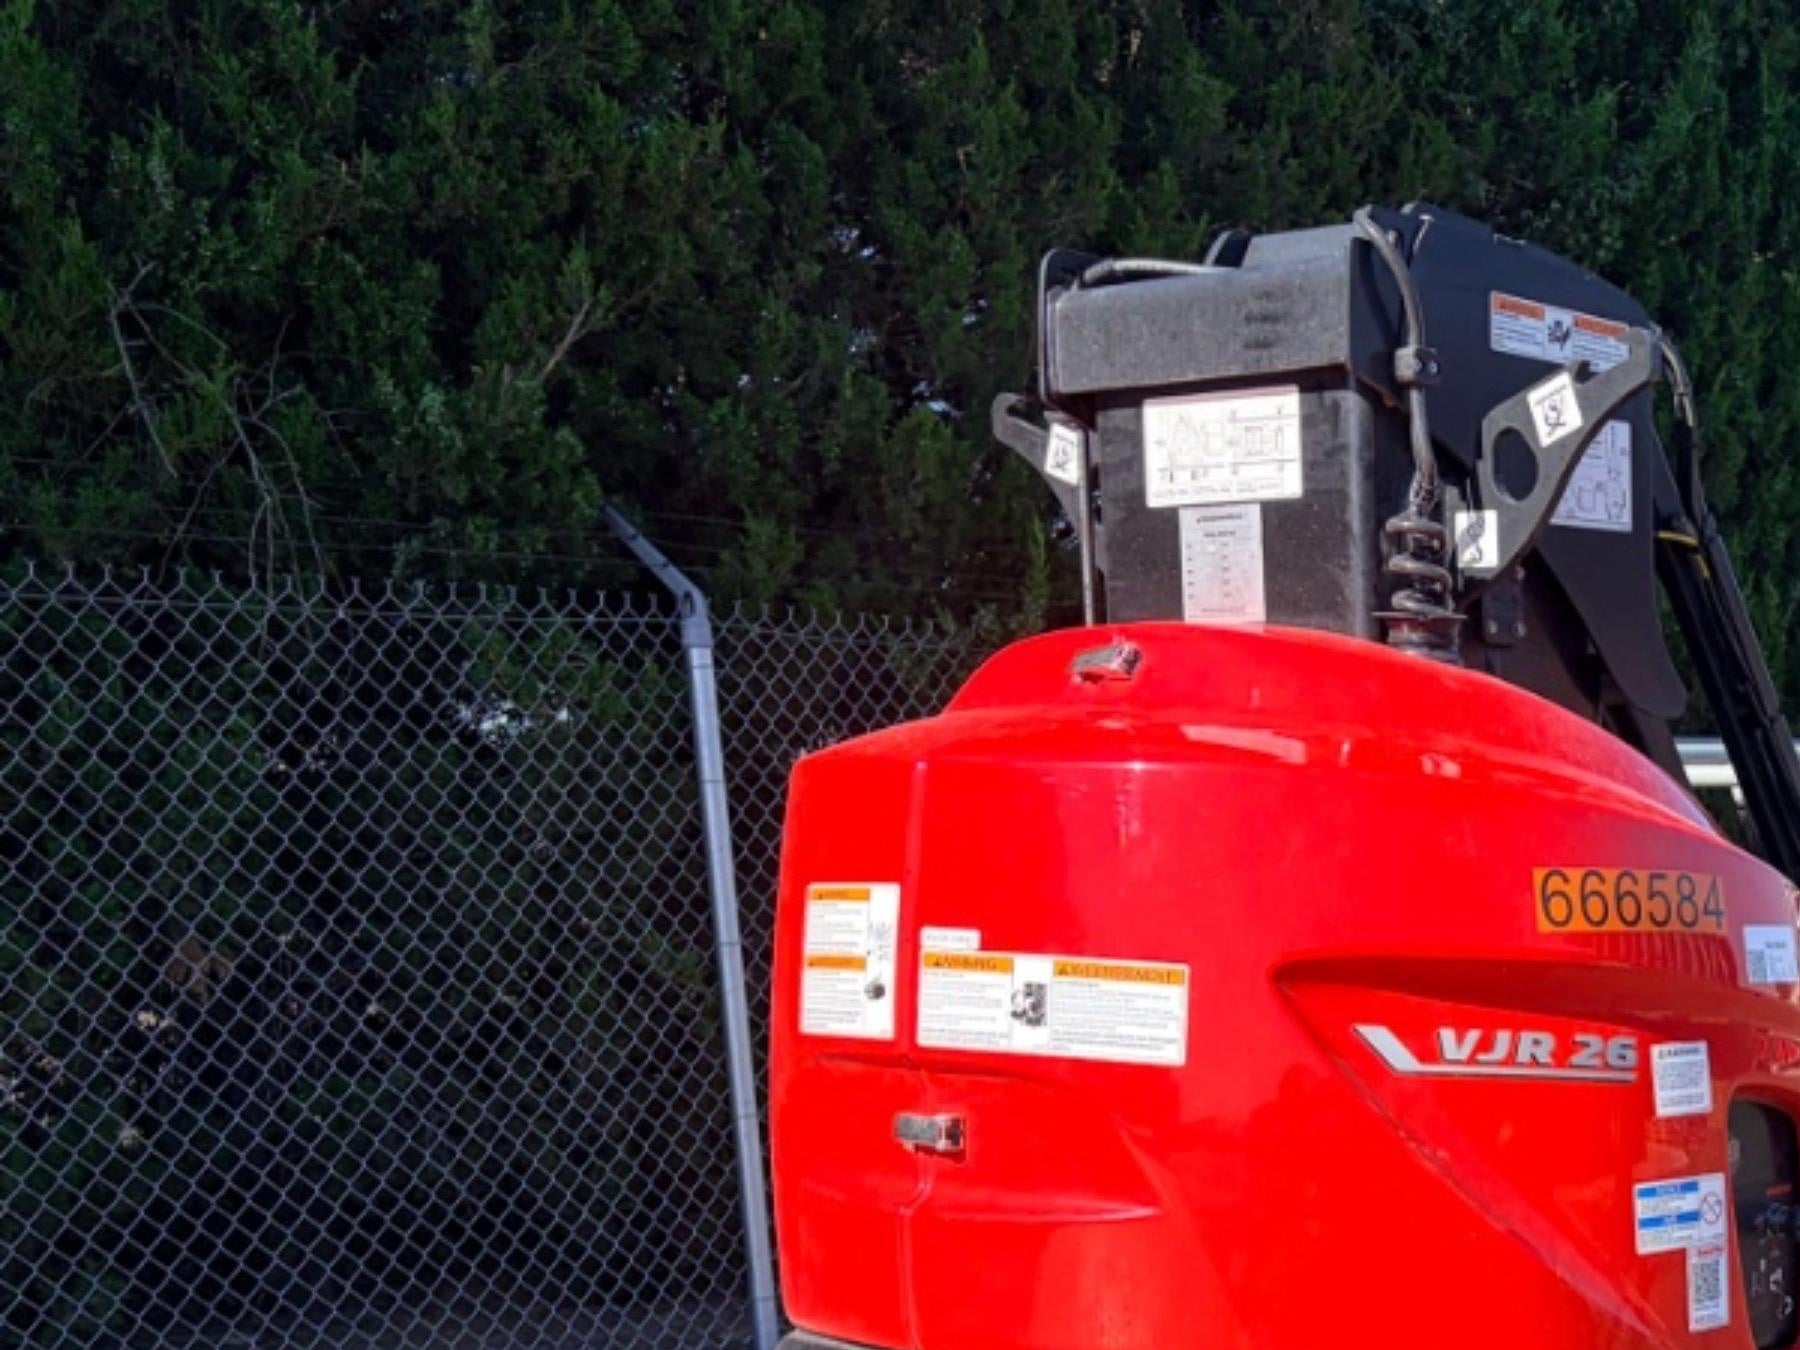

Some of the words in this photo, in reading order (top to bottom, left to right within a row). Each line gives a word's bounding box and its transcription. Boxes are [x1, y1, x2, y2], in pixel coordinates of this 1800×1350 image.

[1541, 870, 1724, 928] 666584
[1438, 1028, 1553, 1066] VJR
[1572, 1033, 1637, 1068] 26
